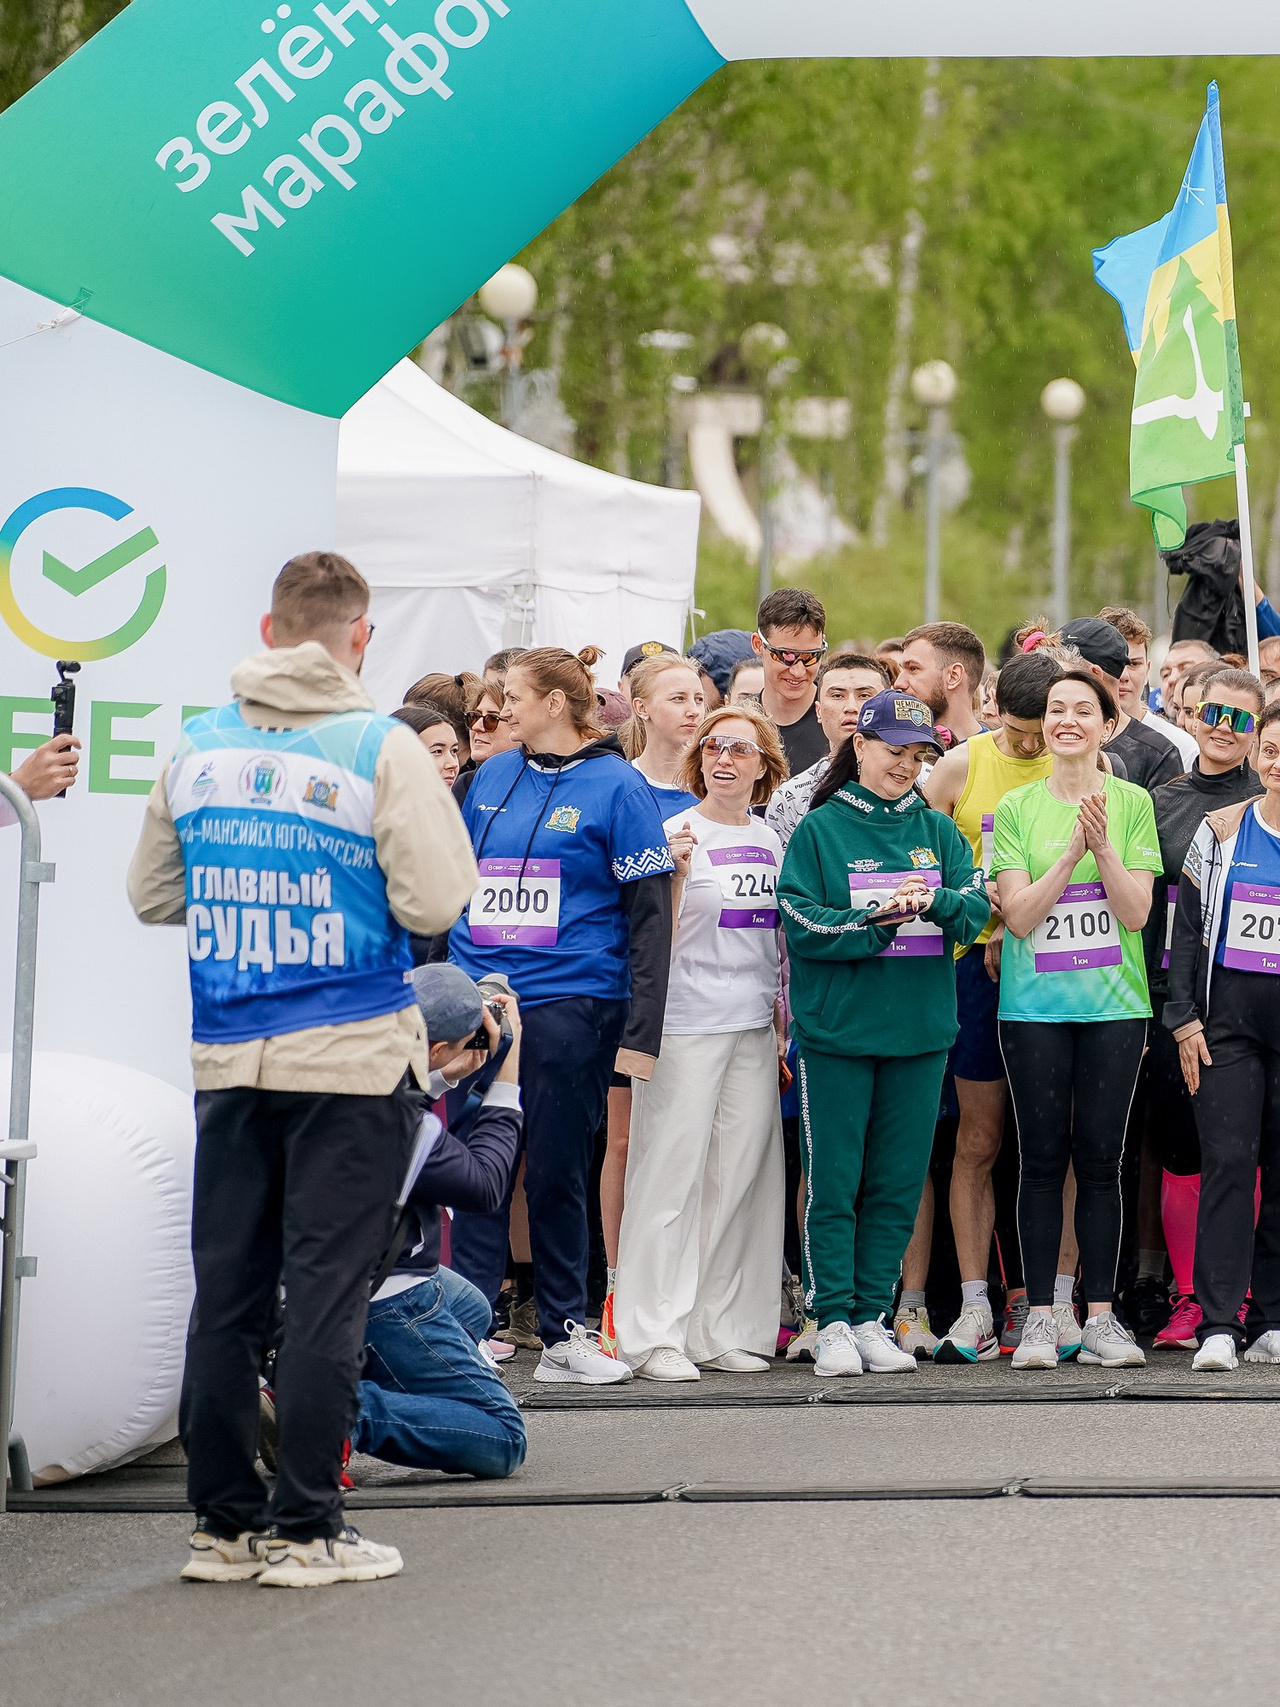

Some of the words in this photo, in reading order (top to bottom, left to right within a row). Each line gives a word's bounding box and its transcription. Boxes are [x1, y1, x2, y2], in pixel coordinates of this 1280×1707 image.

[155, 0, 398, 192] зелён
[210, 0, 511, 257] марафо
[275, 823, 317, 852] ЮГРА
[191, 866, 332, 908] ГЛАВНЫЙ
[482, 888, 549, 913] 2000
[731, 873, 776, 897] 224
[187, 903, 346, 973] СУДЬЯ
[1045, 910, 1110, 940] 2100
